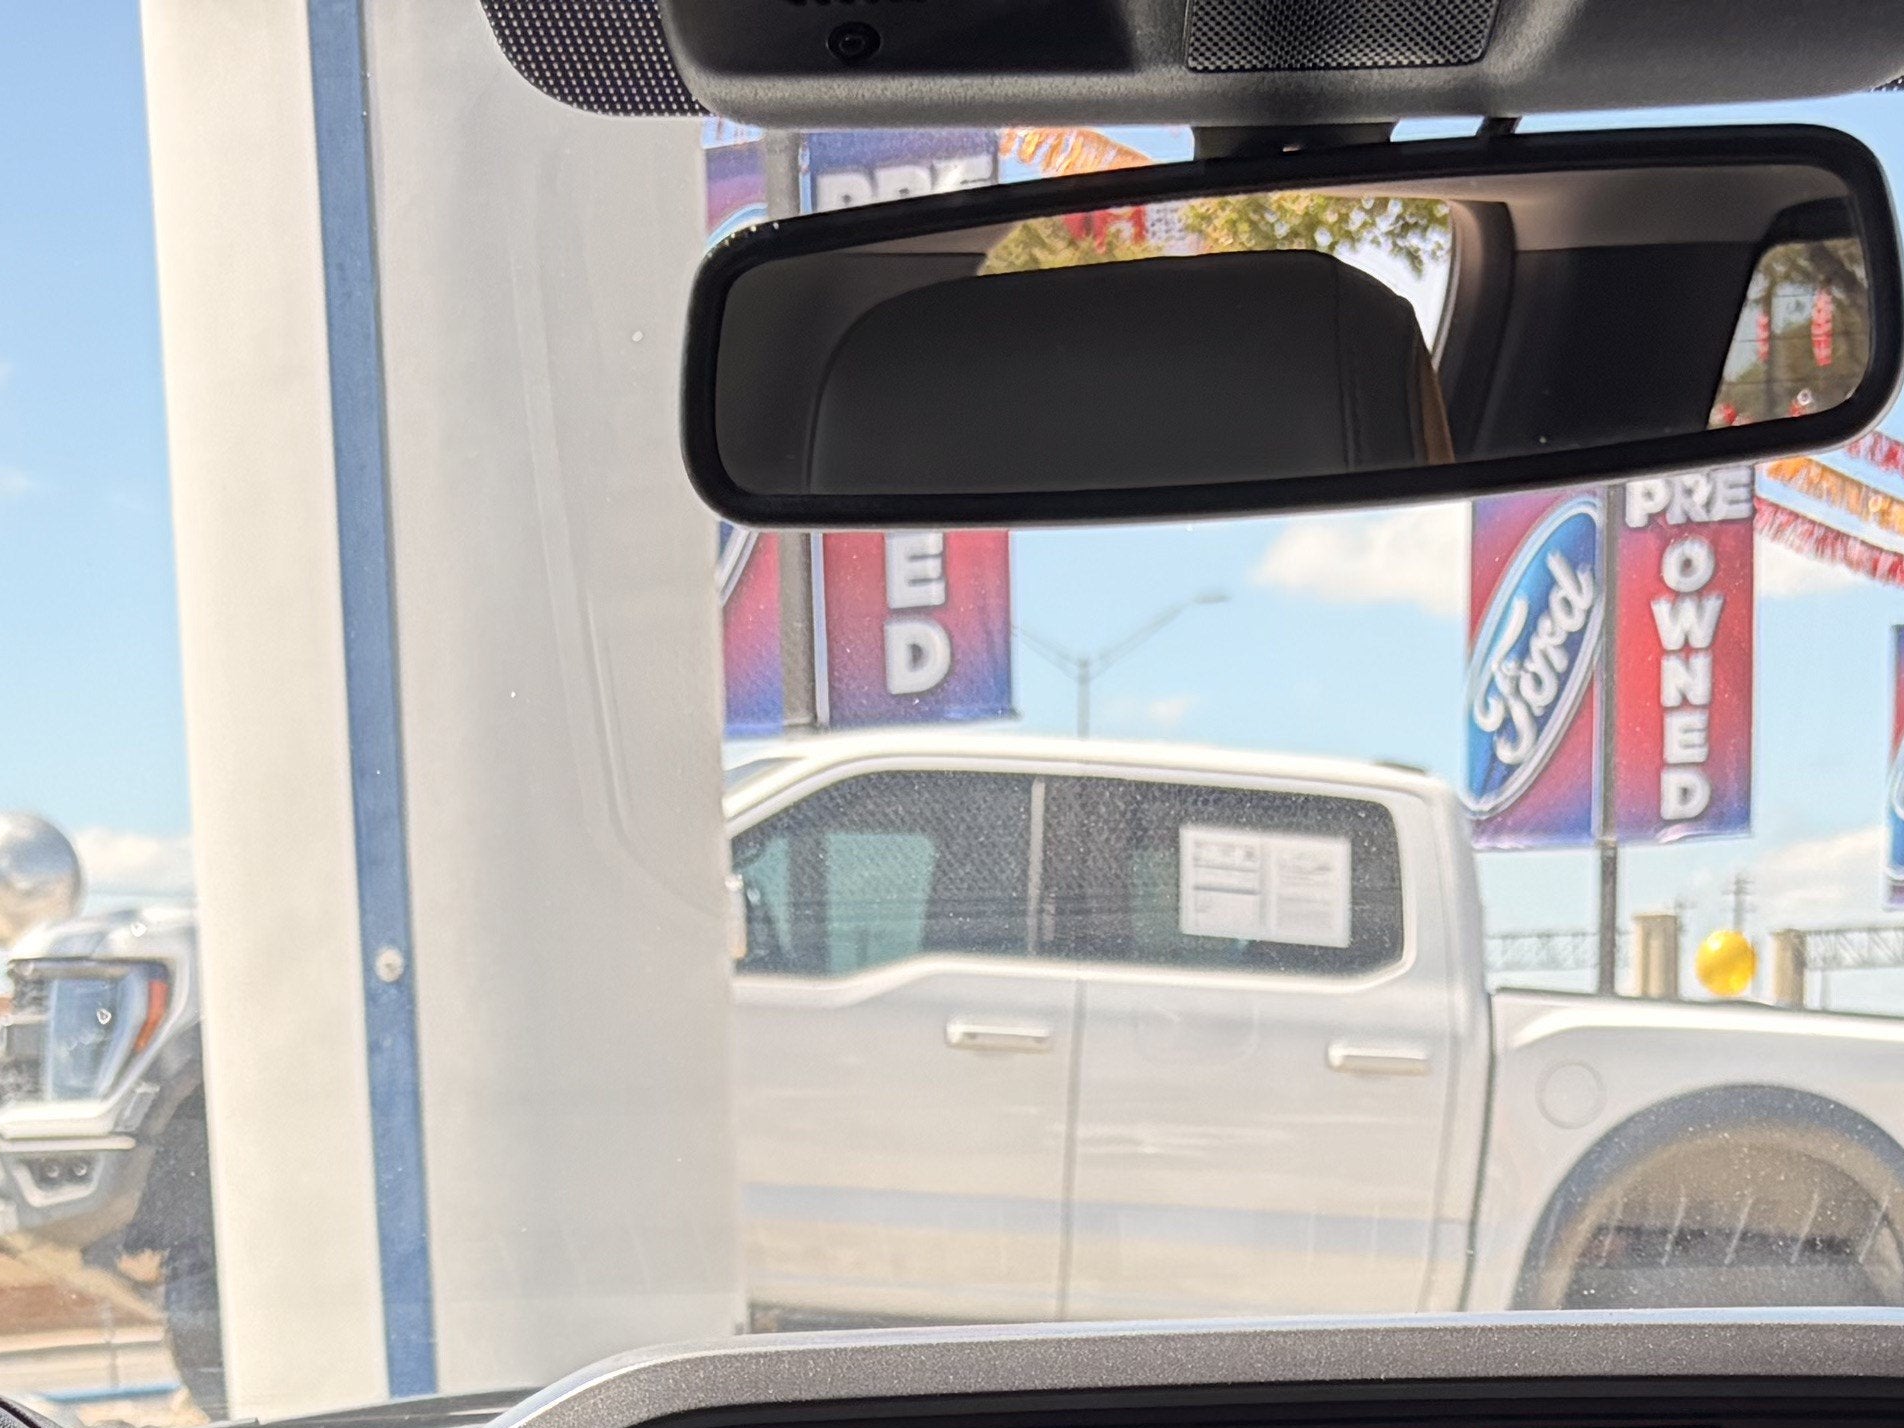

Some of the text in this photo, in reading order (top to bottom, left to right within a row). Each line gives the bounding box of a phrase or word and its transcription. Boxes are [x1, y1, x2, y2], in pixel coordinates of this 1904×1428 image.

[1625, 466, 1753, 528] PRE
[1473, 550, 1595, 766] Ford
[1651, 536, 1724, 820] OWNED
